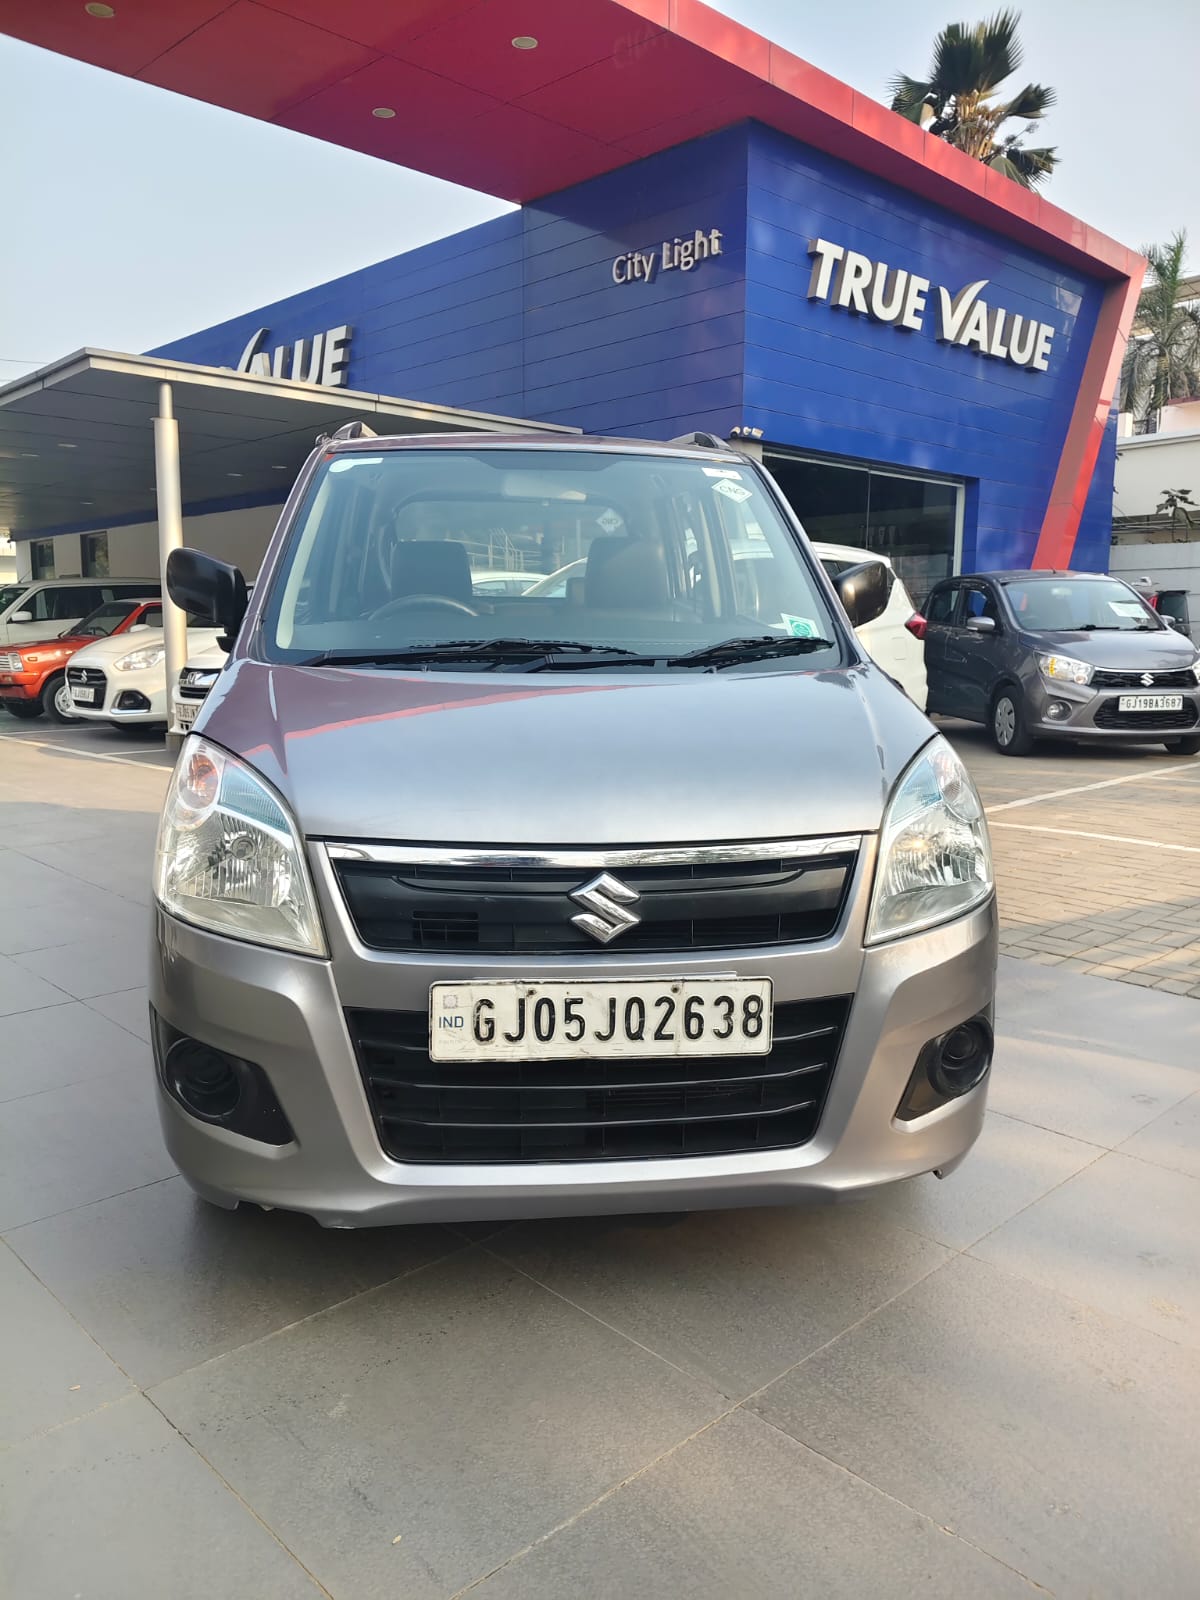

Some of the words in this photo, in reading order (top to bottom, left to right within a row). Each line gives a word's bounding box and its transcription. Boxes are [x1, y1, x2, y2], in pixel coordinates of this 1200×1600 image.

[612, 252, 655, 283] City
[662, 228, 722, 271] Light
[809, 238, 930, 331] TRUE
[936, 279, 1055, 371] VALUE
[437, 1015, 465, 1029] IND
[472, 994, 764, 1043] GJ05JQ2638
